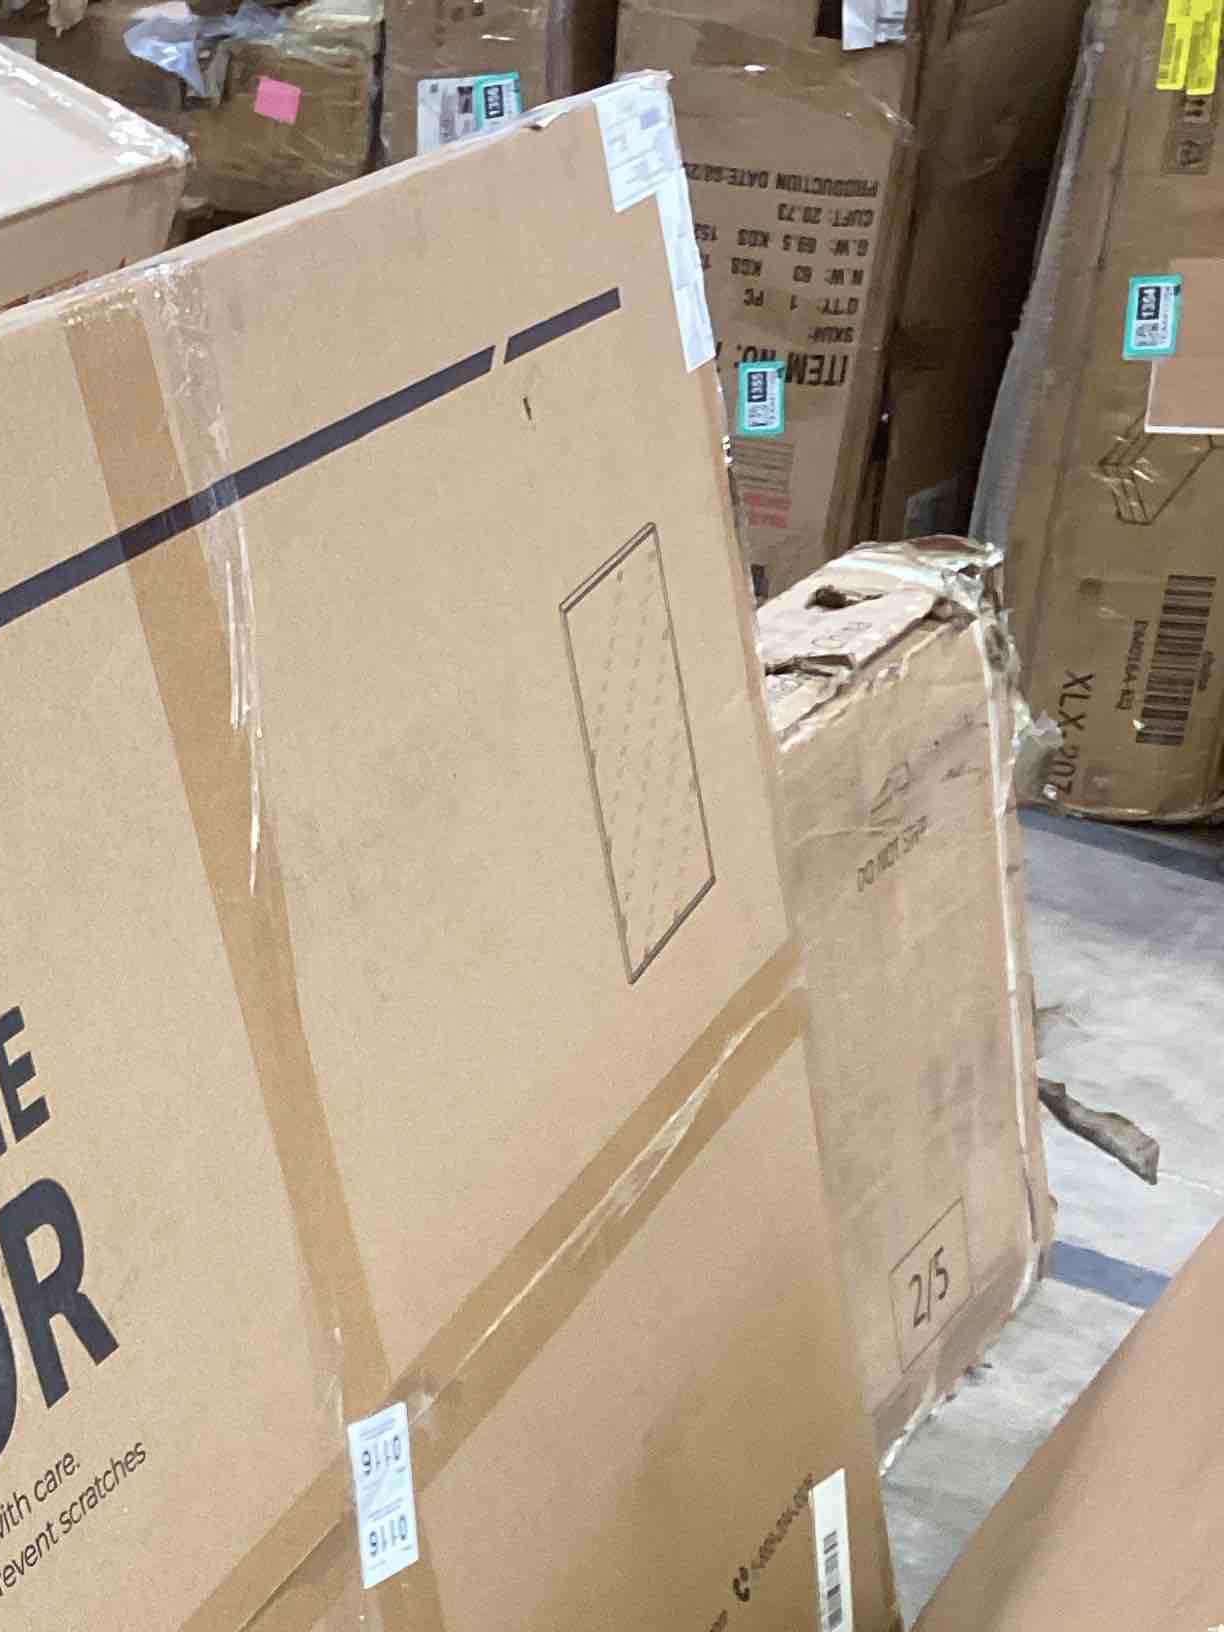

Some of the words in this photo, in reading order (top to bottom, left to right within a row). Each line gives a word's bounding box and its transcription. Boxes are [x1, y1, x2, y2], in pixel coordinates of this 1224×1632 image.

[743, 288, 764, 308] PC
[785, 352, 849, 387] ITEM
[908, 1245, 950, 1331] 2/5
[32, 1451, 82, 1504] care.
[58, 1439, 148, 1535] scratches
